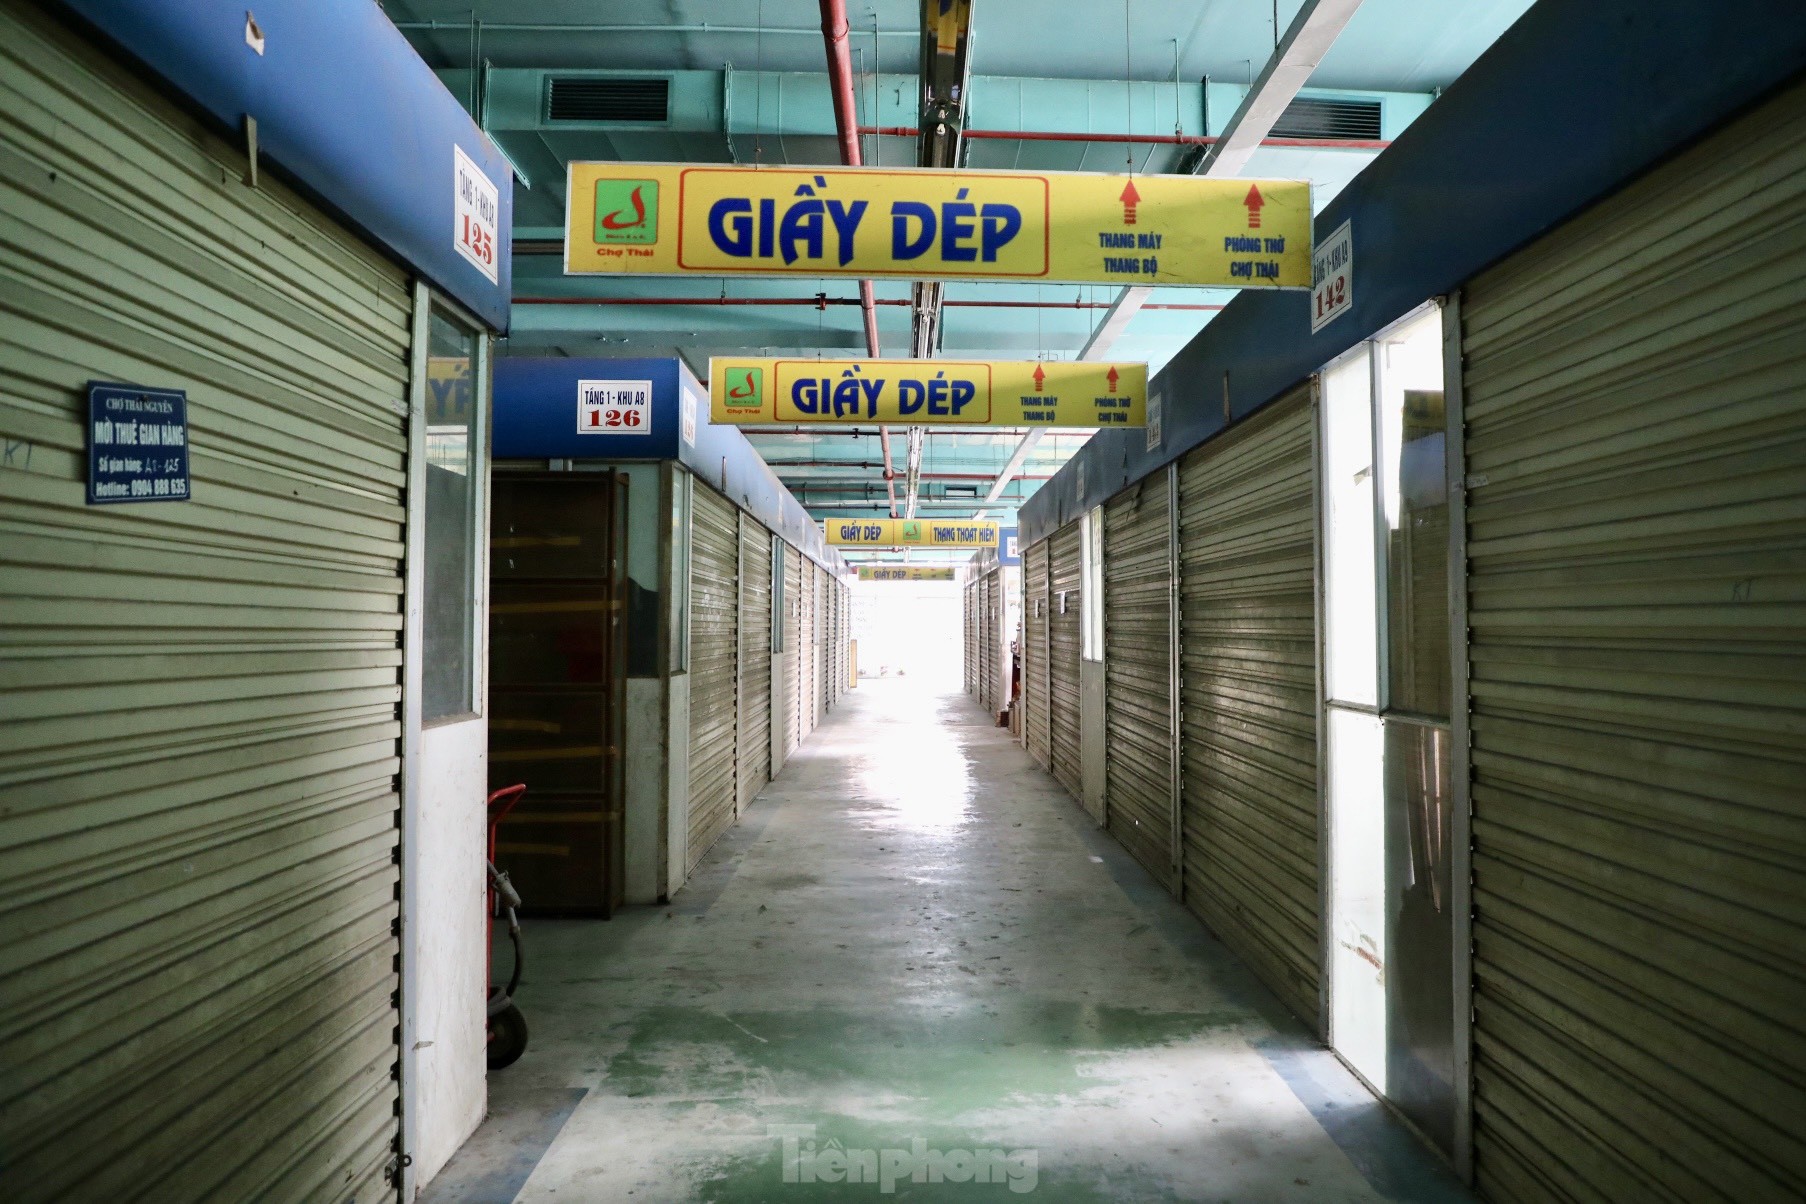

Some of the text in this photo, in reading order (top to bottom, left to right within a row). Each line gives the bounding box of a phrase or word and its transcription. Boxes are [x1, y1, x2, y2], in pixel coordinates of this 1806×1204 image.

[707, 175, 1023, 267] GIẦY DÉP
[461, 213, 492, 265] 125
[1099, 231, 1162, 250] THANG MÁY
[1224, 233, 1286, 254] PHÒNG THỜ
[1104, 255, 1158, 278] THANG BỘ
[1230, 259, 1280, 280] CHỢ THÁI
[1315, 275, 1346, 320] 142
[617, 391, 633, 406] KHU
[634, 391, 645, 406] A8
[791, 364, 976, 419] GIẦY DÉP
[1020, 396, 1042, 406] THANG
[106, 398, 124, 412] CHỢ
[587, 409, 641, 427] 126
[1023, 411, 1045, 421] THANG
[95, 416, 184, 446] MỜI THUÊ GIAN HÀNG
[109, 457, 124, 474] gian
[96, 478, 186, 497] Hotline: 0904 888 635
[864, 522, 882, 541] DÉP
[933, 526, 955, 543] THANG
